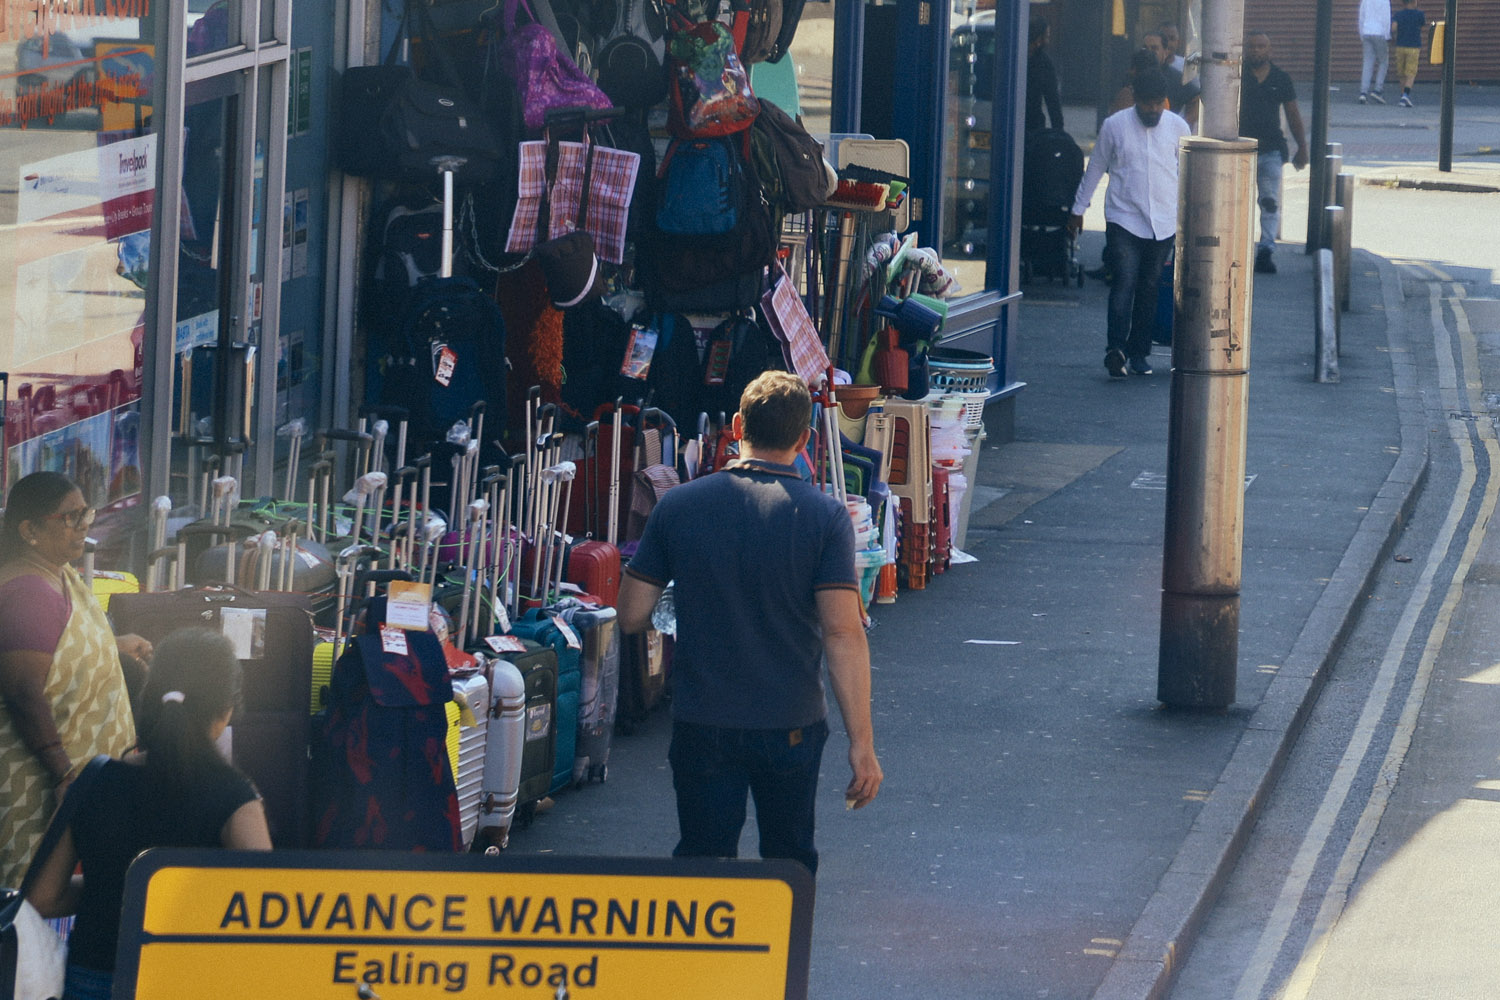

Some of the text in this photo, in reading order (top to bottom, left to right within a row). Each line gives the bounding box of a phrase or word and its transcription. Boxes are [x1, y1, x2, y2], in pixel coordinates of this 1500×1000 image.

[220, 890, 738, 939] ADVANCE WARNING
[332, 950, 599, 993] Ealing Road
